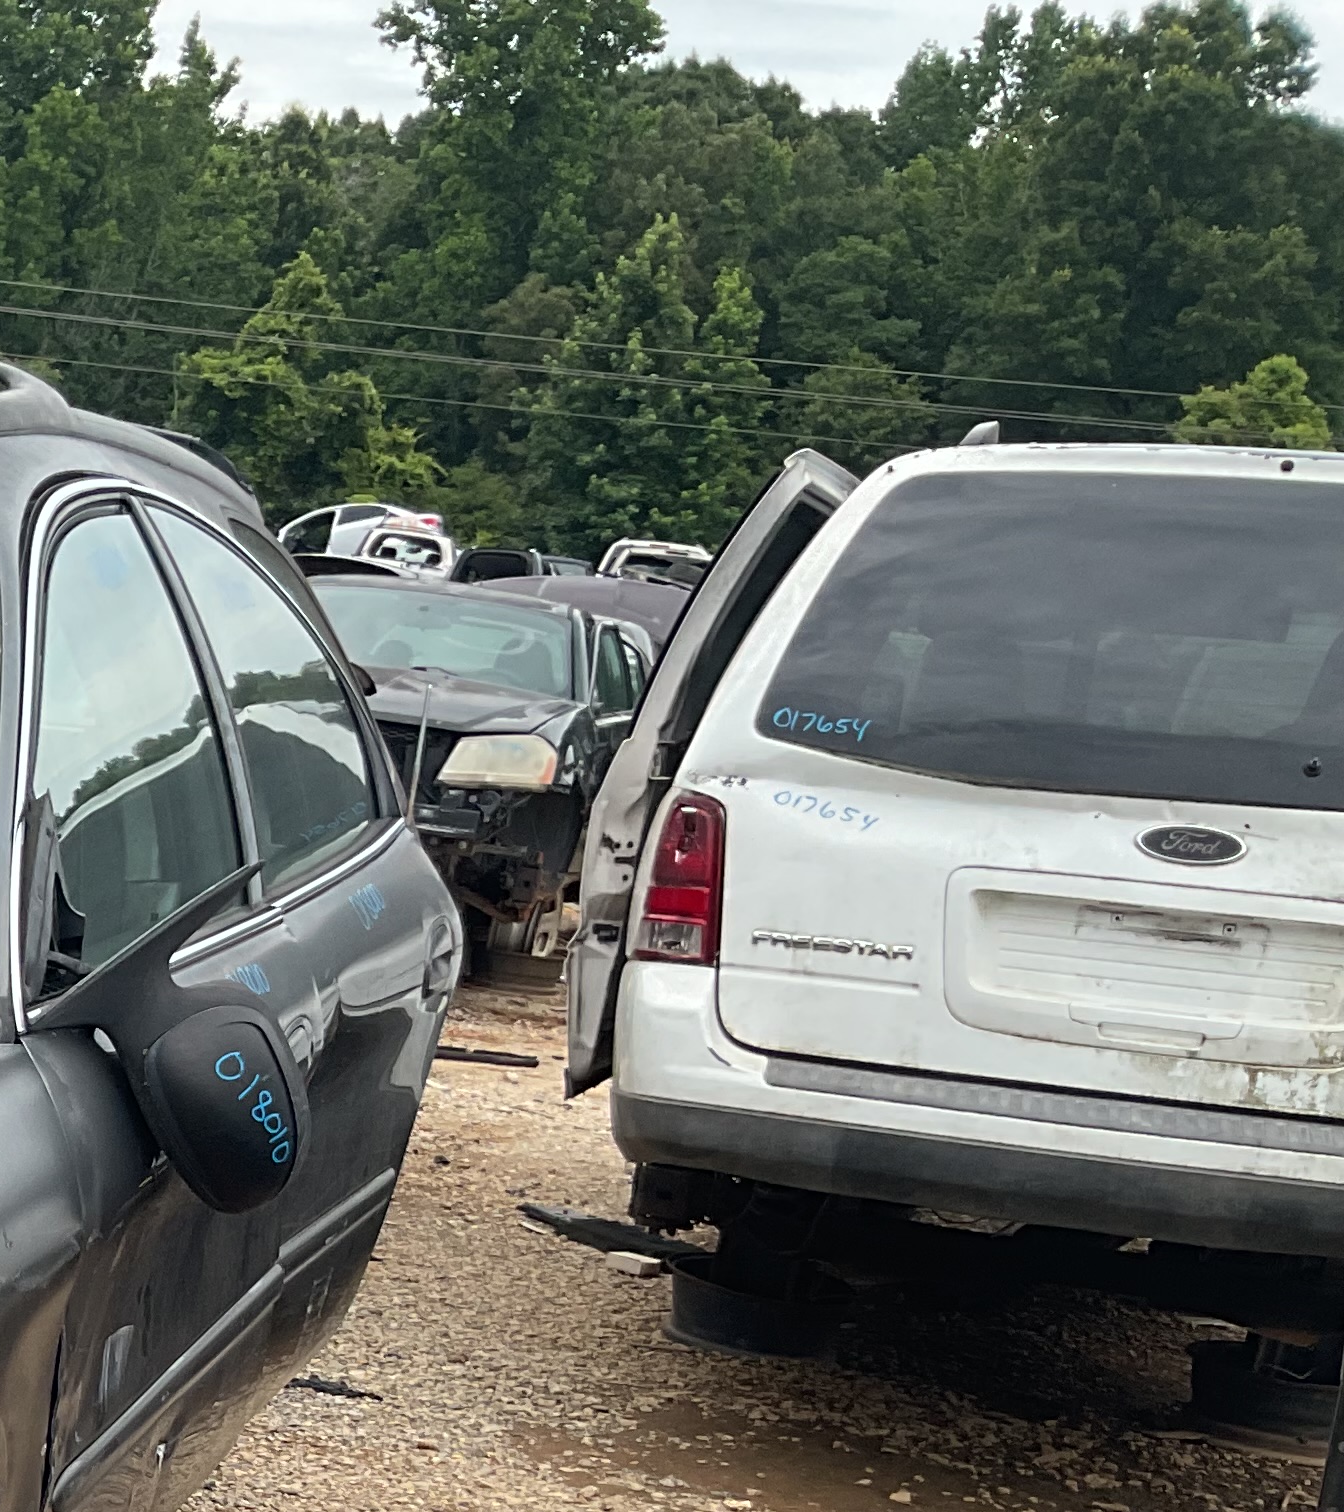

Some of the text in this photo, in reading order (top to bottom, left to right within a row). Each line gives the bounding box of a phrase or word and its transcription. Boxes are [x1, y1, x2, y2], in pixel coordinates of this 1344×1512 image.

[772, 707, 873, 742] 017654
[773, 791, 880, 831] 017654
[1161, 830, 1222, 855] Ford
[751, 928, 914, 960] FREESTAR
[215, 1051, 290, 1163] 018010
